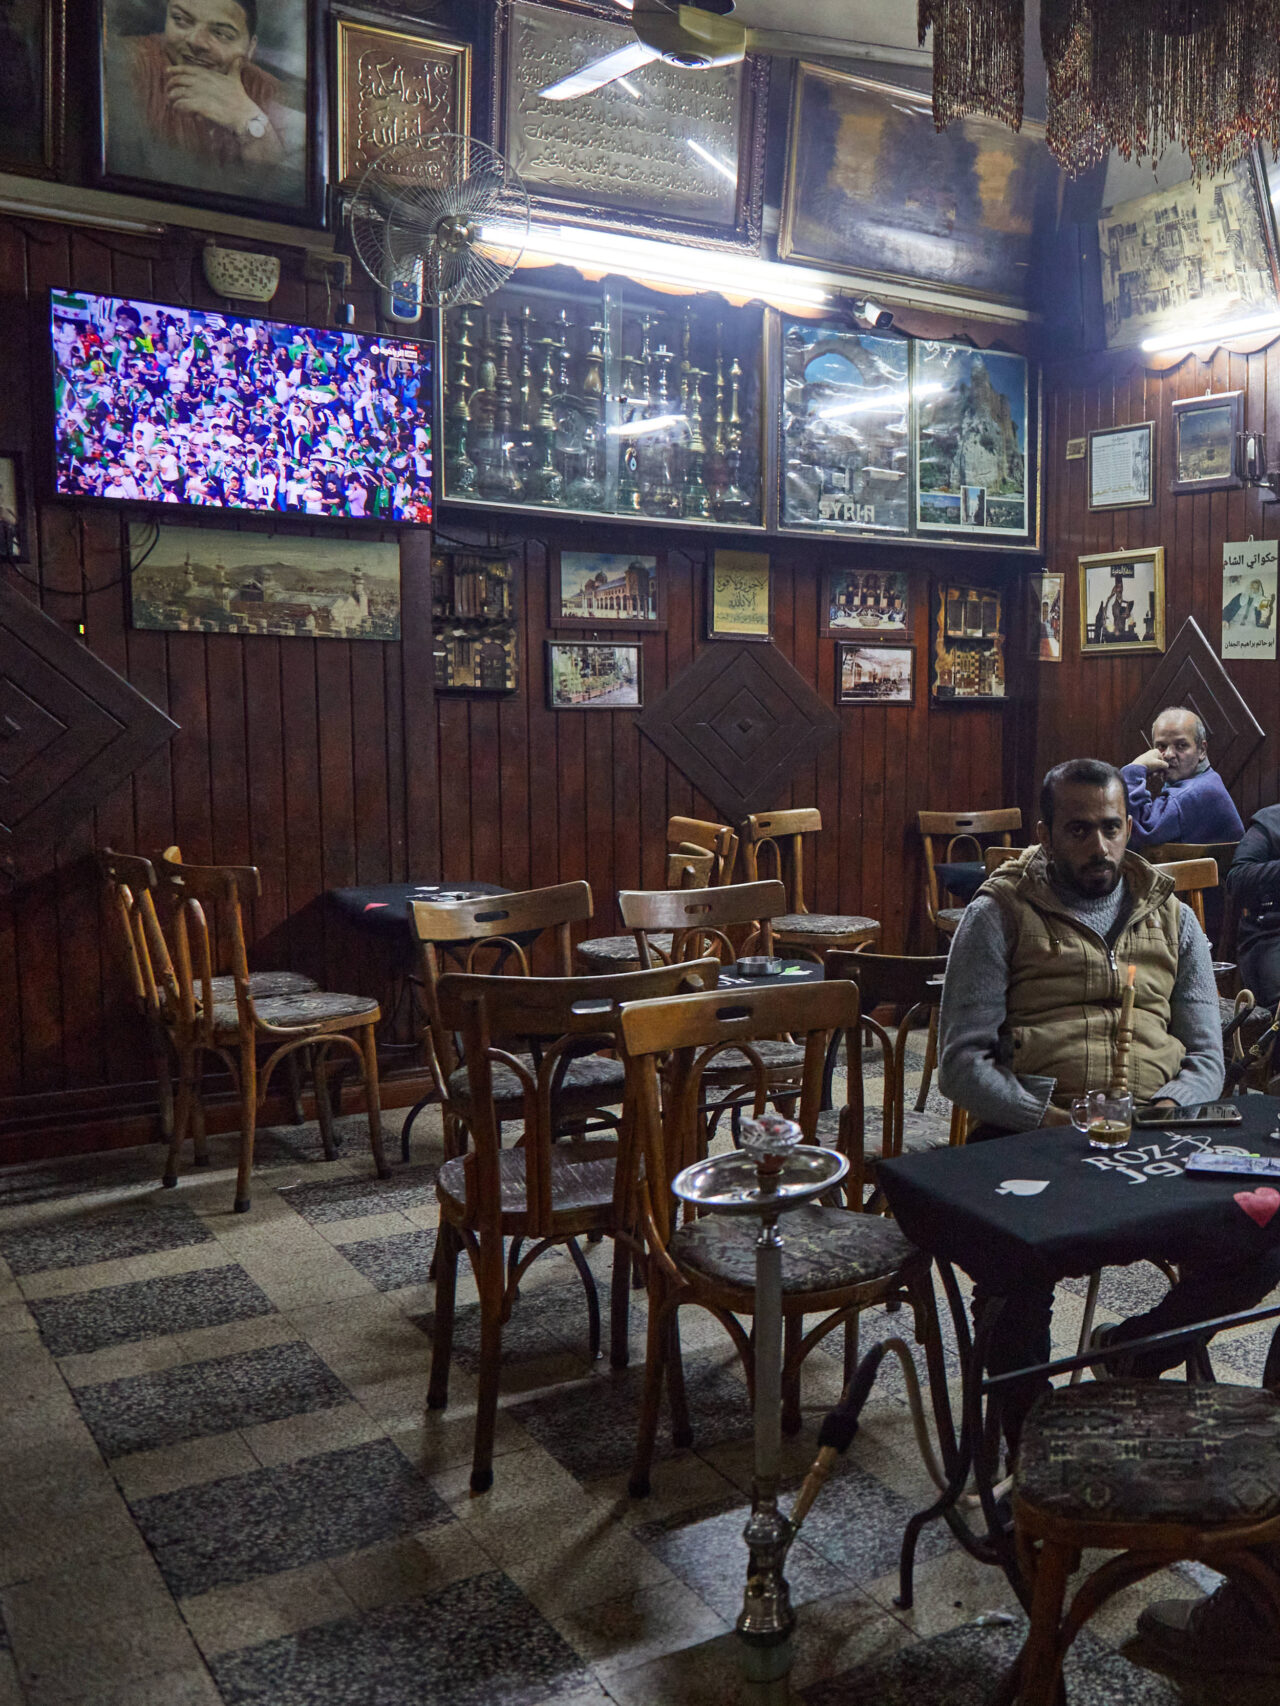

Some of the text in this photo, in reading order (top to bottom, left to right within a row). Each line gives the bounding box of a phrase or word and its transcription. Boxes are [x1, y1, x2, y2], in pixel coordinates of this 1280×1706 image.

[818, 500, 876, 523] SYRIA
[1246, 551, 1279, 569] حكواتي
[1080, 1143, 1180, 1171] ROZ
